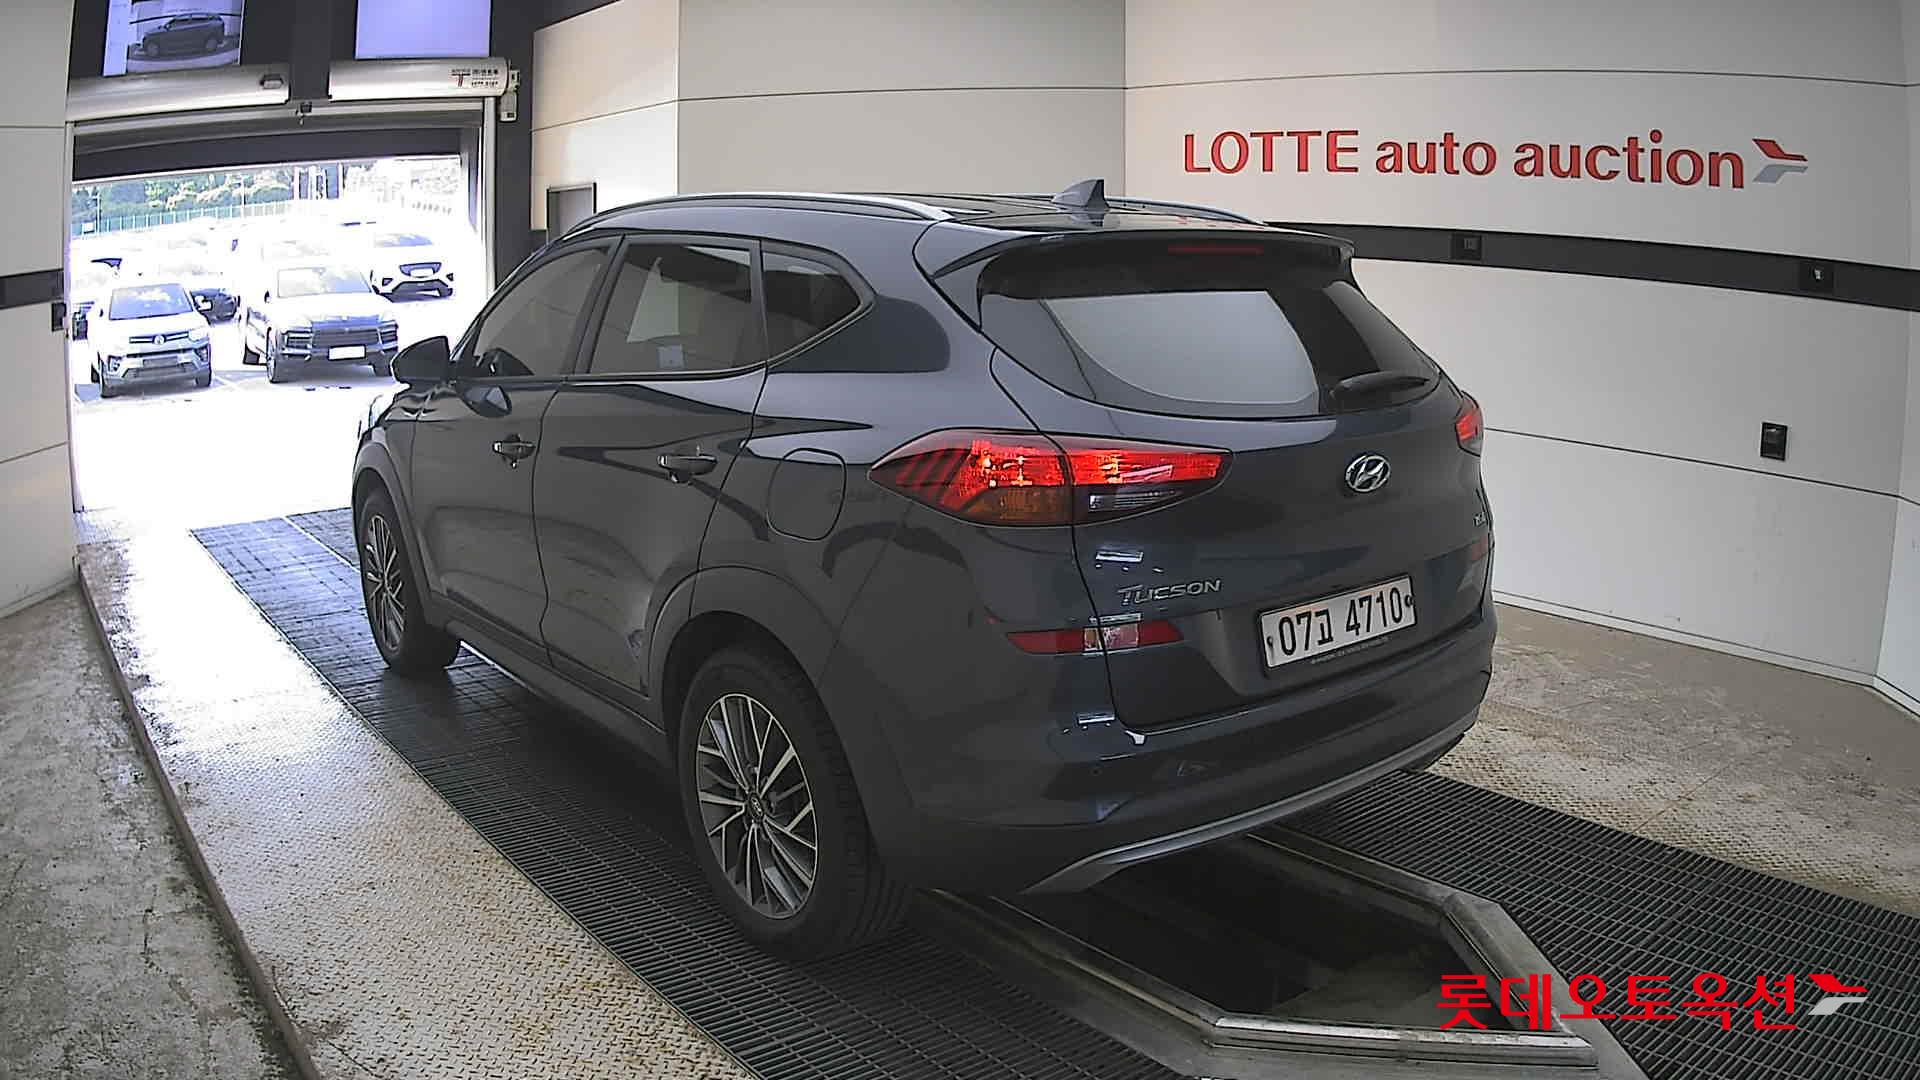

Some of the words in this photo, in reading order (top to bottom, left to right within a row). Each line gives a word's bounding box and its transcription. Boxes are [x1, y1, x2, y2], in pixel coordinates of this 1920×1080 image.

[1184, 130, 1359, 175] LOTTE
[1376, 132, 1498, 176] auto
[1513, 130, 1745, 189] auction
[1117, 579, 1221, 605] TUCSON
[1345, 586, 1404, 636] 4710
